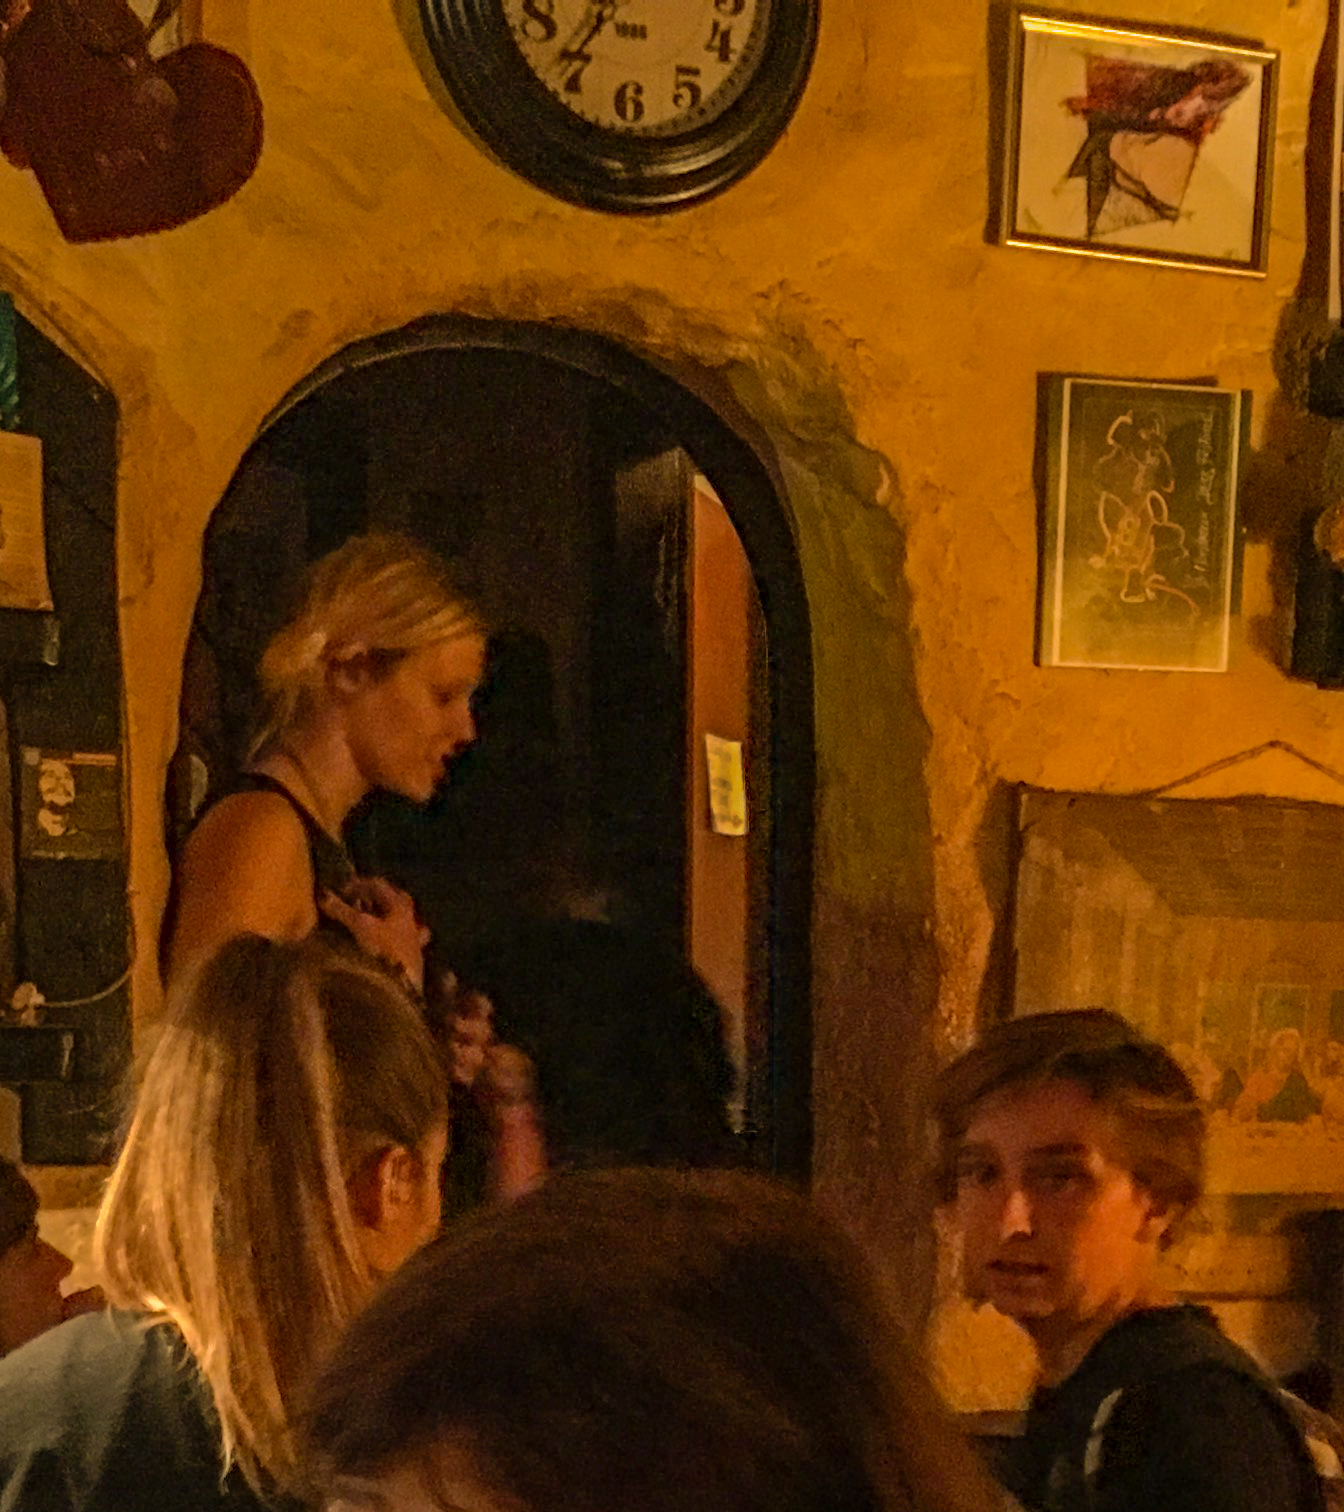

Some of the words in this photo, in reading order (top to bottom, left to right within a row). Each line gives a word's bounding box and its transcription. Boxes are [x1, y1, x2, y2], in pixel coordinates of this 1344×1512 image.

[521, 0, 556, 42] 8
[704, 18, 736, 62] 4
[559, 48, 592, 94] 7
[672, 64, 702, 109] 5
[613, 80, 644, 123] 6
